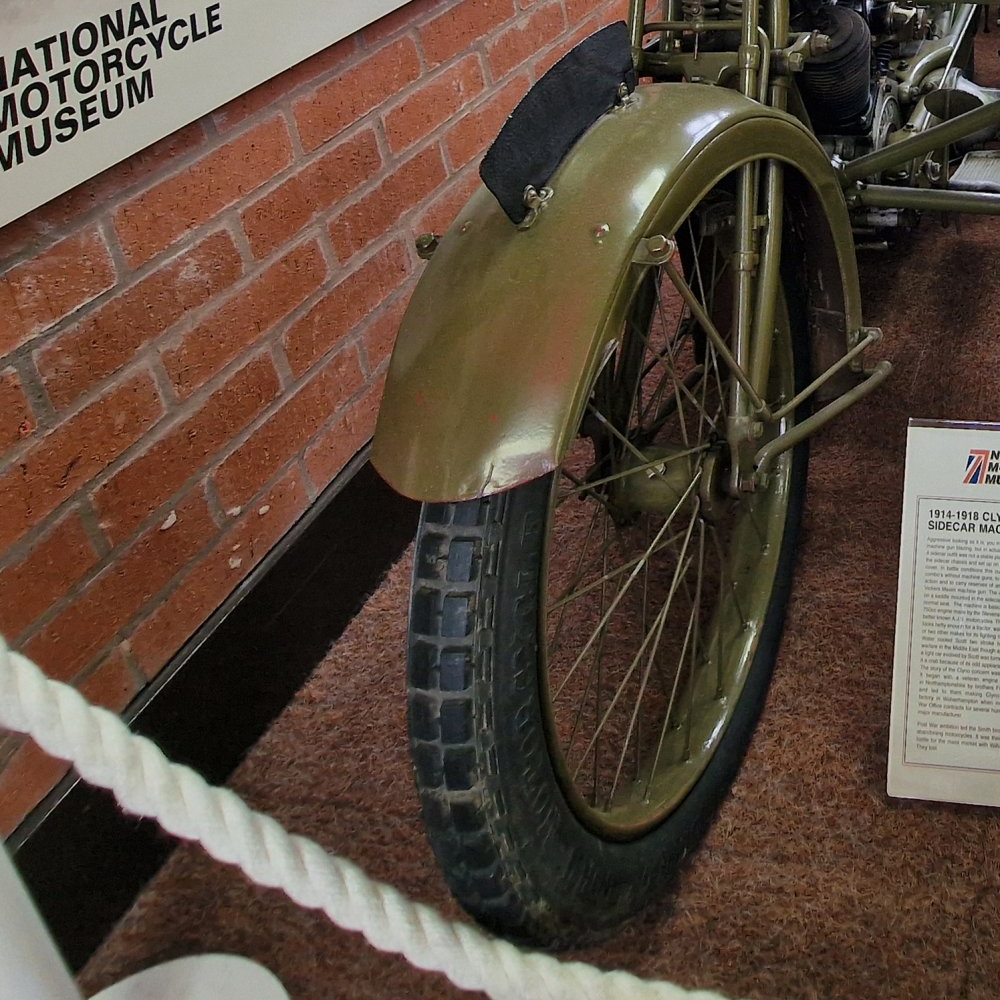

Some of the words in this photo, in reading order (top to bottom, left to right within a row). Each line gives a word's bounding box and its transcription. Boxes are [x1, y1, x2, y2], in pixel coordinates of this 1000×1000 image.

[0, 68, 154, 172] MUSEUM
[929, 509, 980, 521] 1914-1918
[928, 521, 976, 533] SIDECAR
